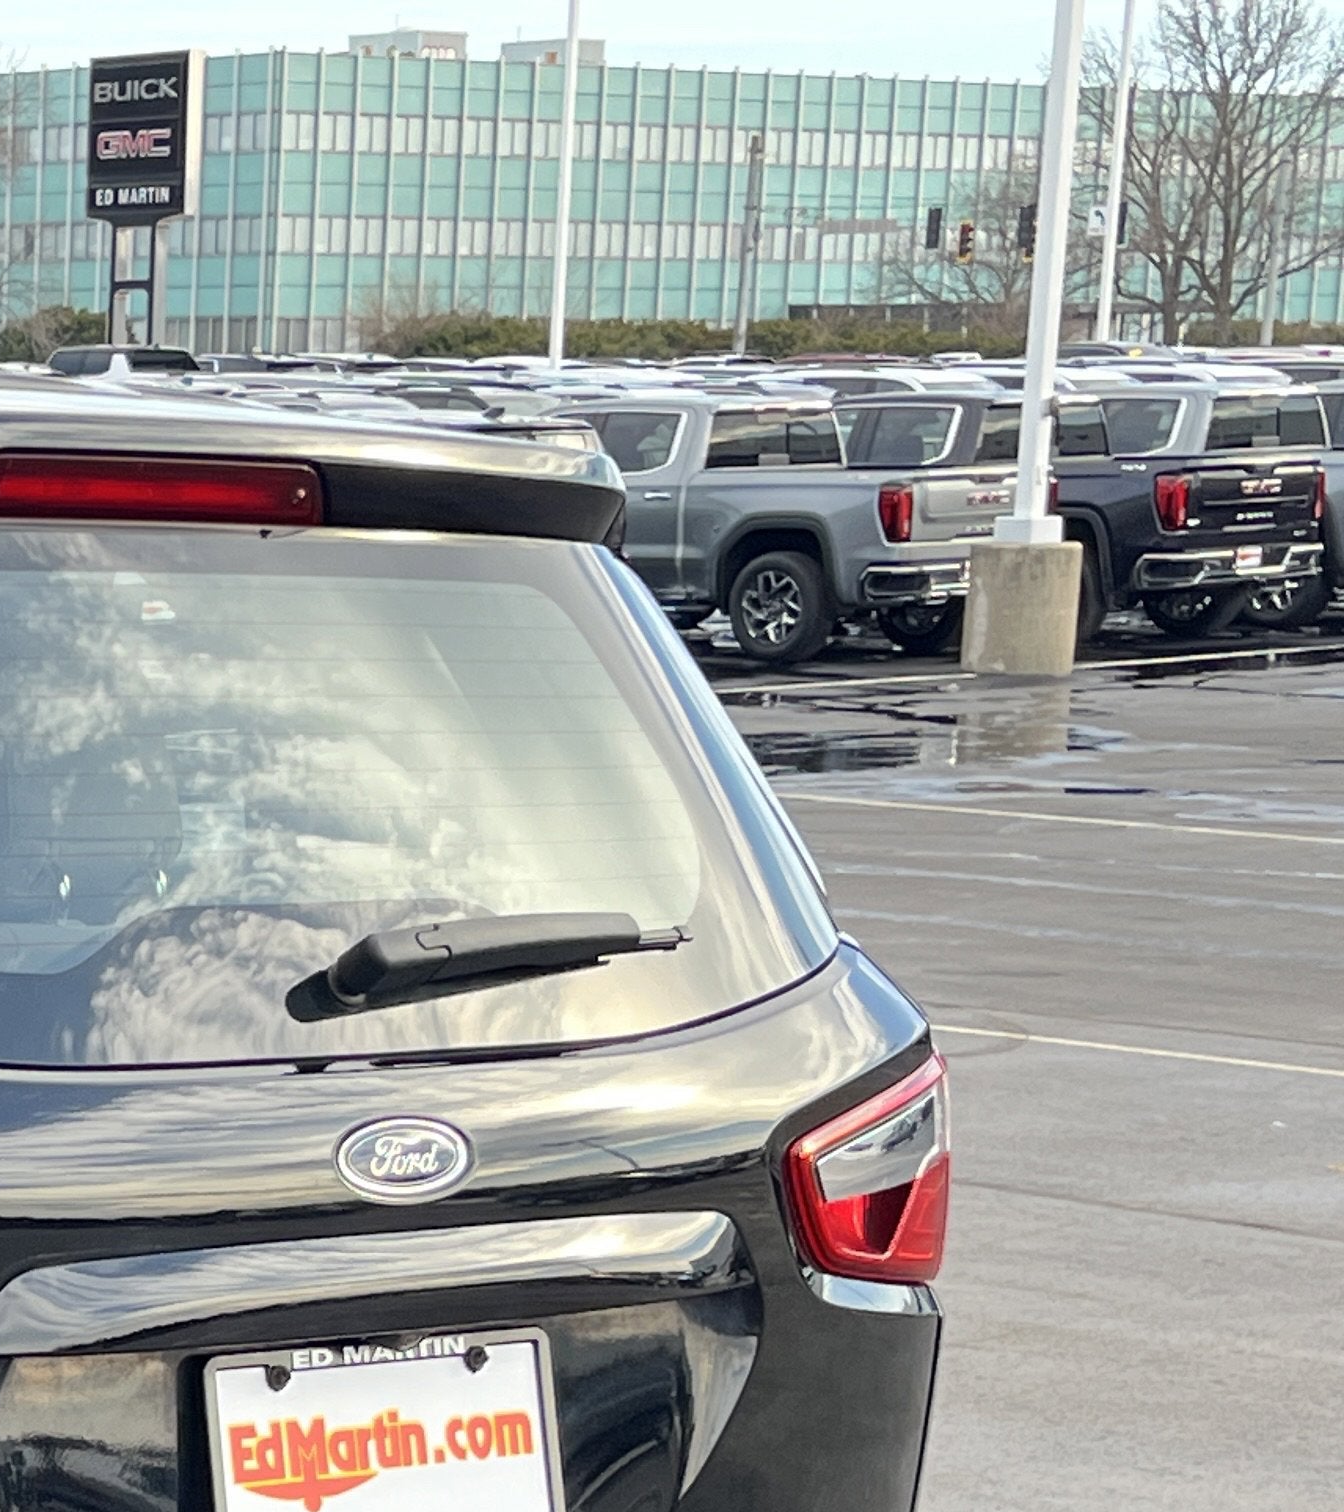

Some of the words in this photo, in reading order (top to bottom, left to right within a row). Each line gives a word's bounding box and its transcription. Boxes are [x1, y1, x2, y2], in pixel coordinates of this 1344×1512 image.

[93, 76, 178, 103] BUICK
[96, 127, 172, 160] GMC
[95, 188, 113, 206] ED
[117, 186, 170, 205] MARTIN
[370, 1136, 440, 1177] Ford
[292, 1348, 334, 1370] ED
